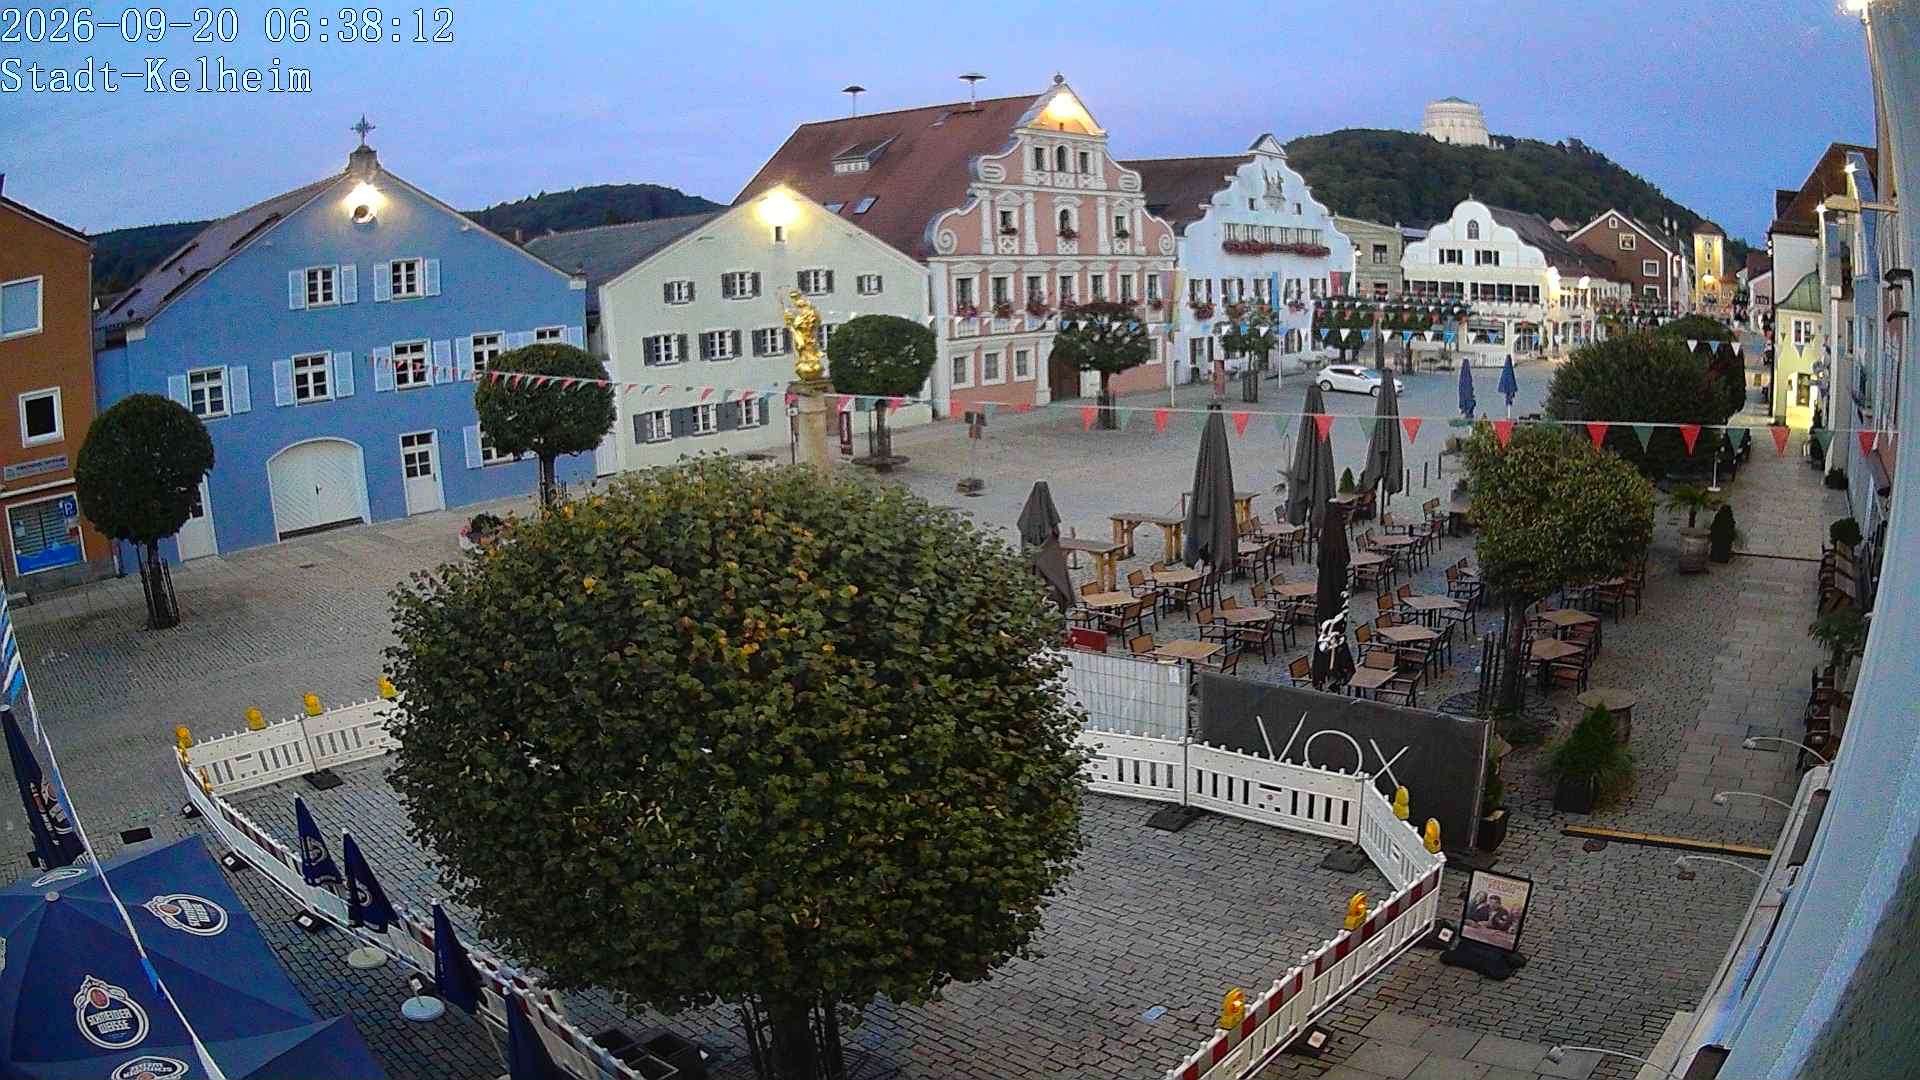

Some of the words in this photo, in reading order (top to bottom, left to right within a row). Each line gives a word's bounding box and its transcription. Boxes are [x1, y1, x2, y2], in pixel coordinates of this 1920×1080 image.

[1256, 711, 1409, 789] VOX
[86, 1008, 133, 1026] SCHNEIDER
[97, 1019, 132, 1034] WEISSE
